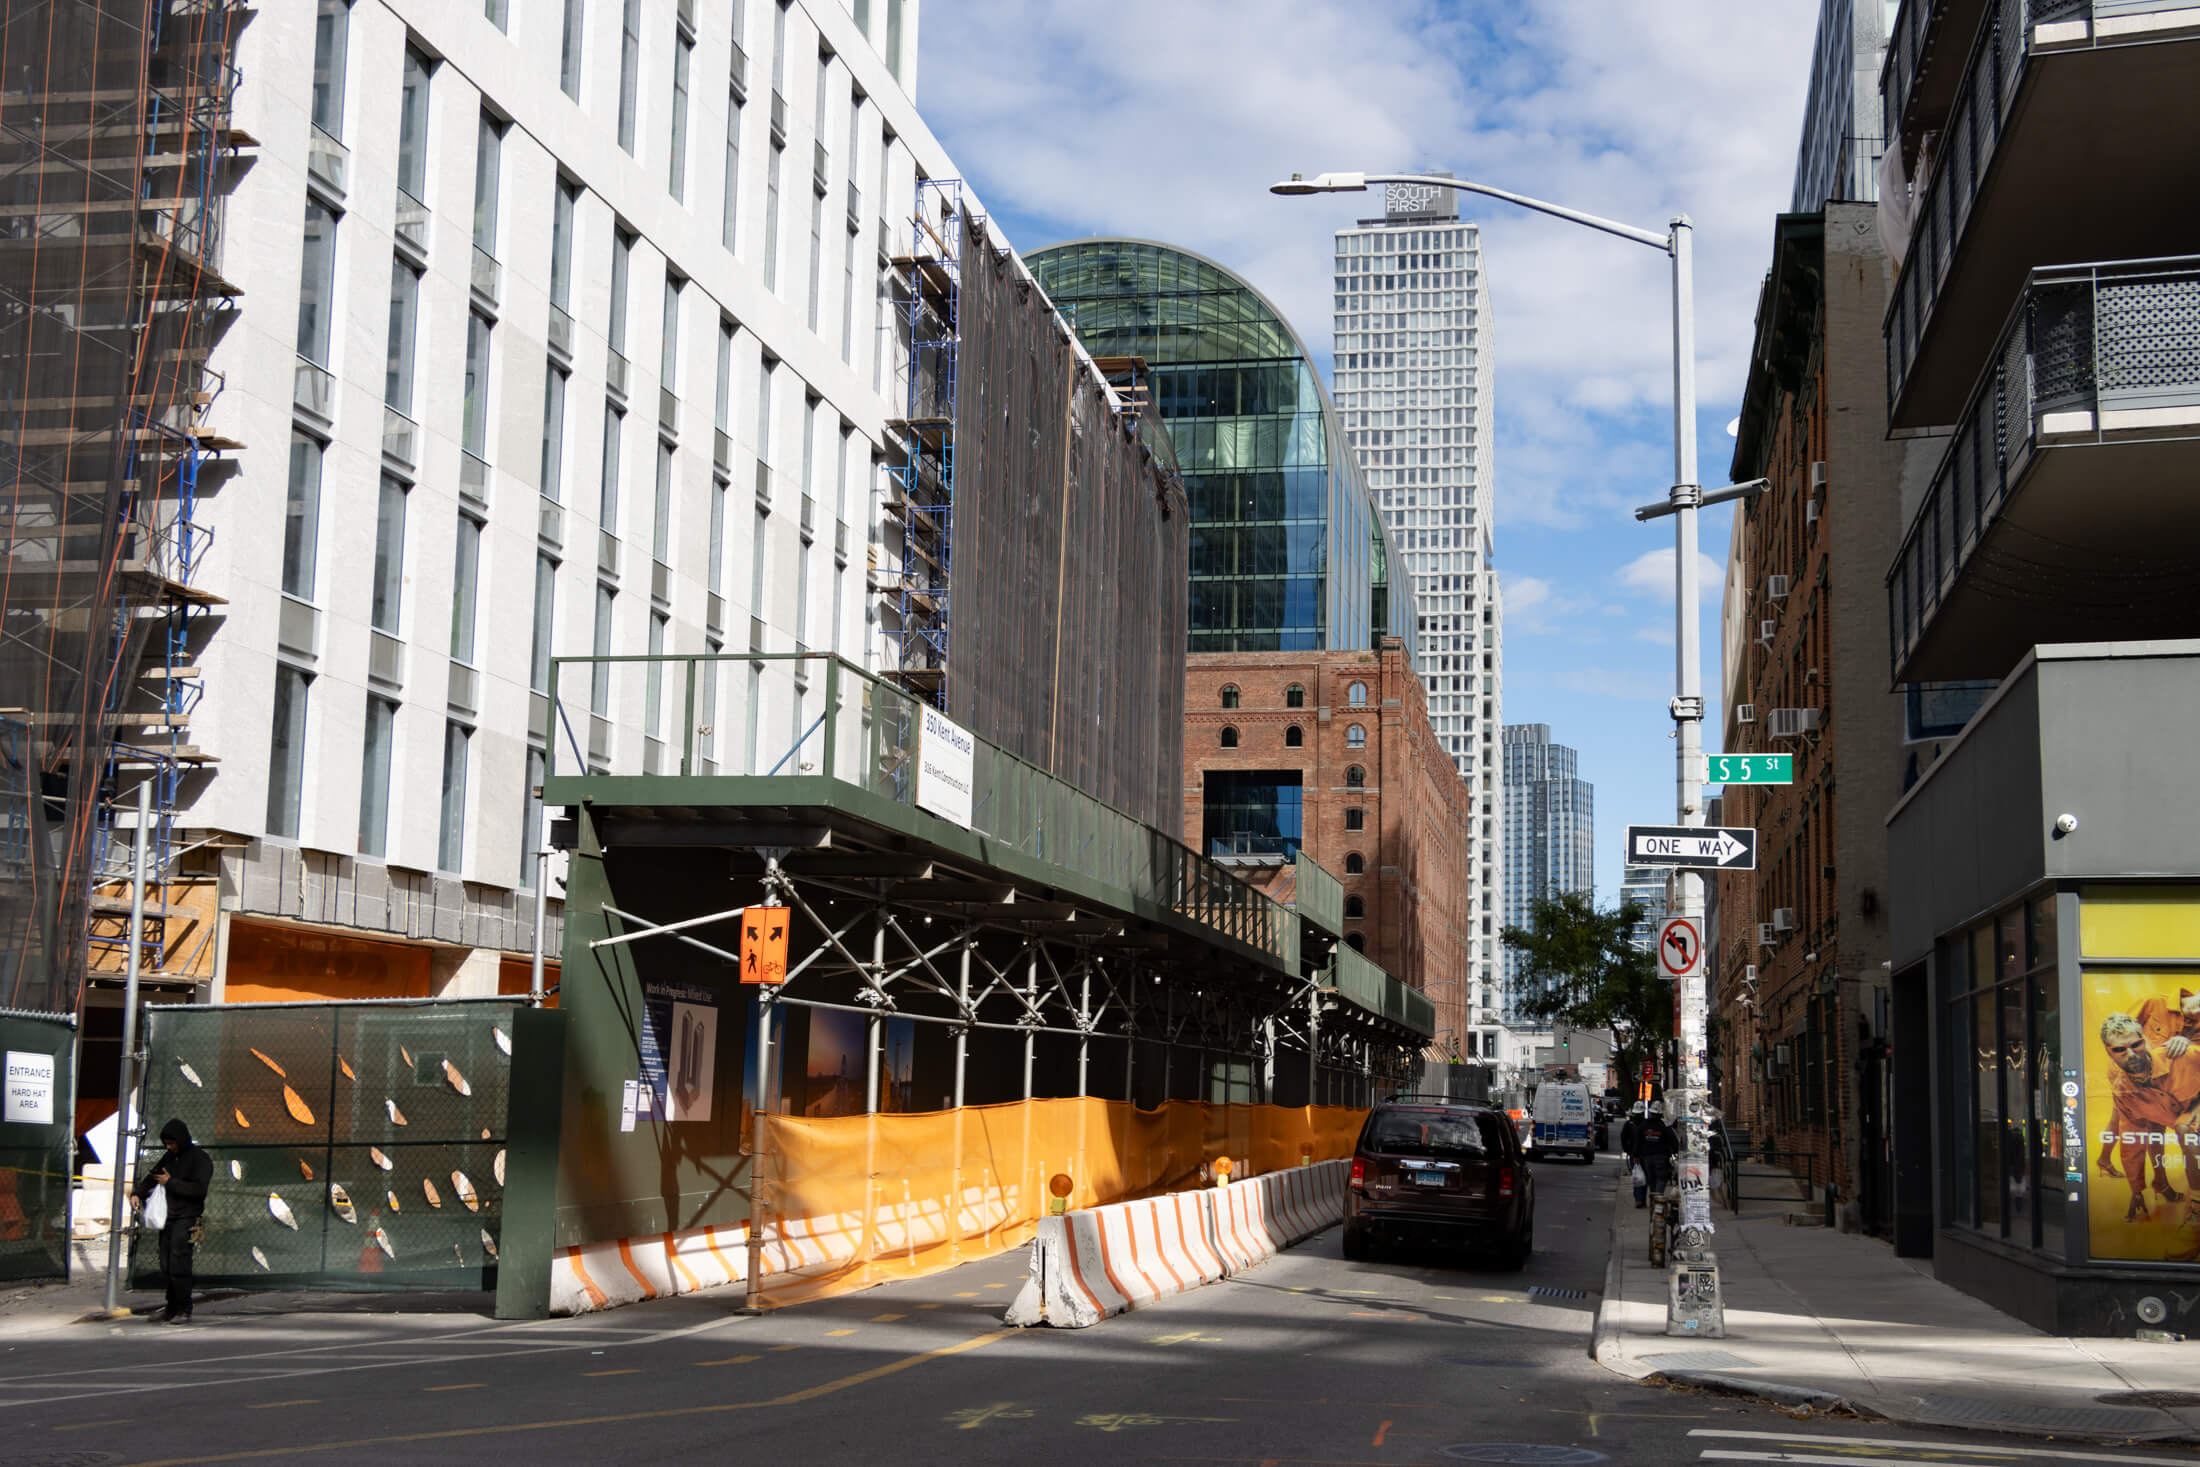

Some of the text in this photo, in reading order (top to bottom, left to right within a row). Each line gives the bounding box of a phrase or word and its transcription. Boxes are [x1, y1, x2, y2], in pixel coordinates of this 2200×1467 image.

[1386, 186, 1441, 200] SOUTH
[1386, 199, 1430, 212] FIRST
[926, 713, 970, 755] 350 Kent Avenue
[1719, 757, 1780, 781] S 5 St
[1646, 838, 1735, 856] ONE WAY
[9, 1066, 51, 1078] ENTRANCE
[12, 1087, 47, 1098] HARD HAT
[19, 1099, 39, 1109] AREA
[2098, 1130, 2180, 1146] G-STAR
[2183, 1132, 2200, 1146] R
